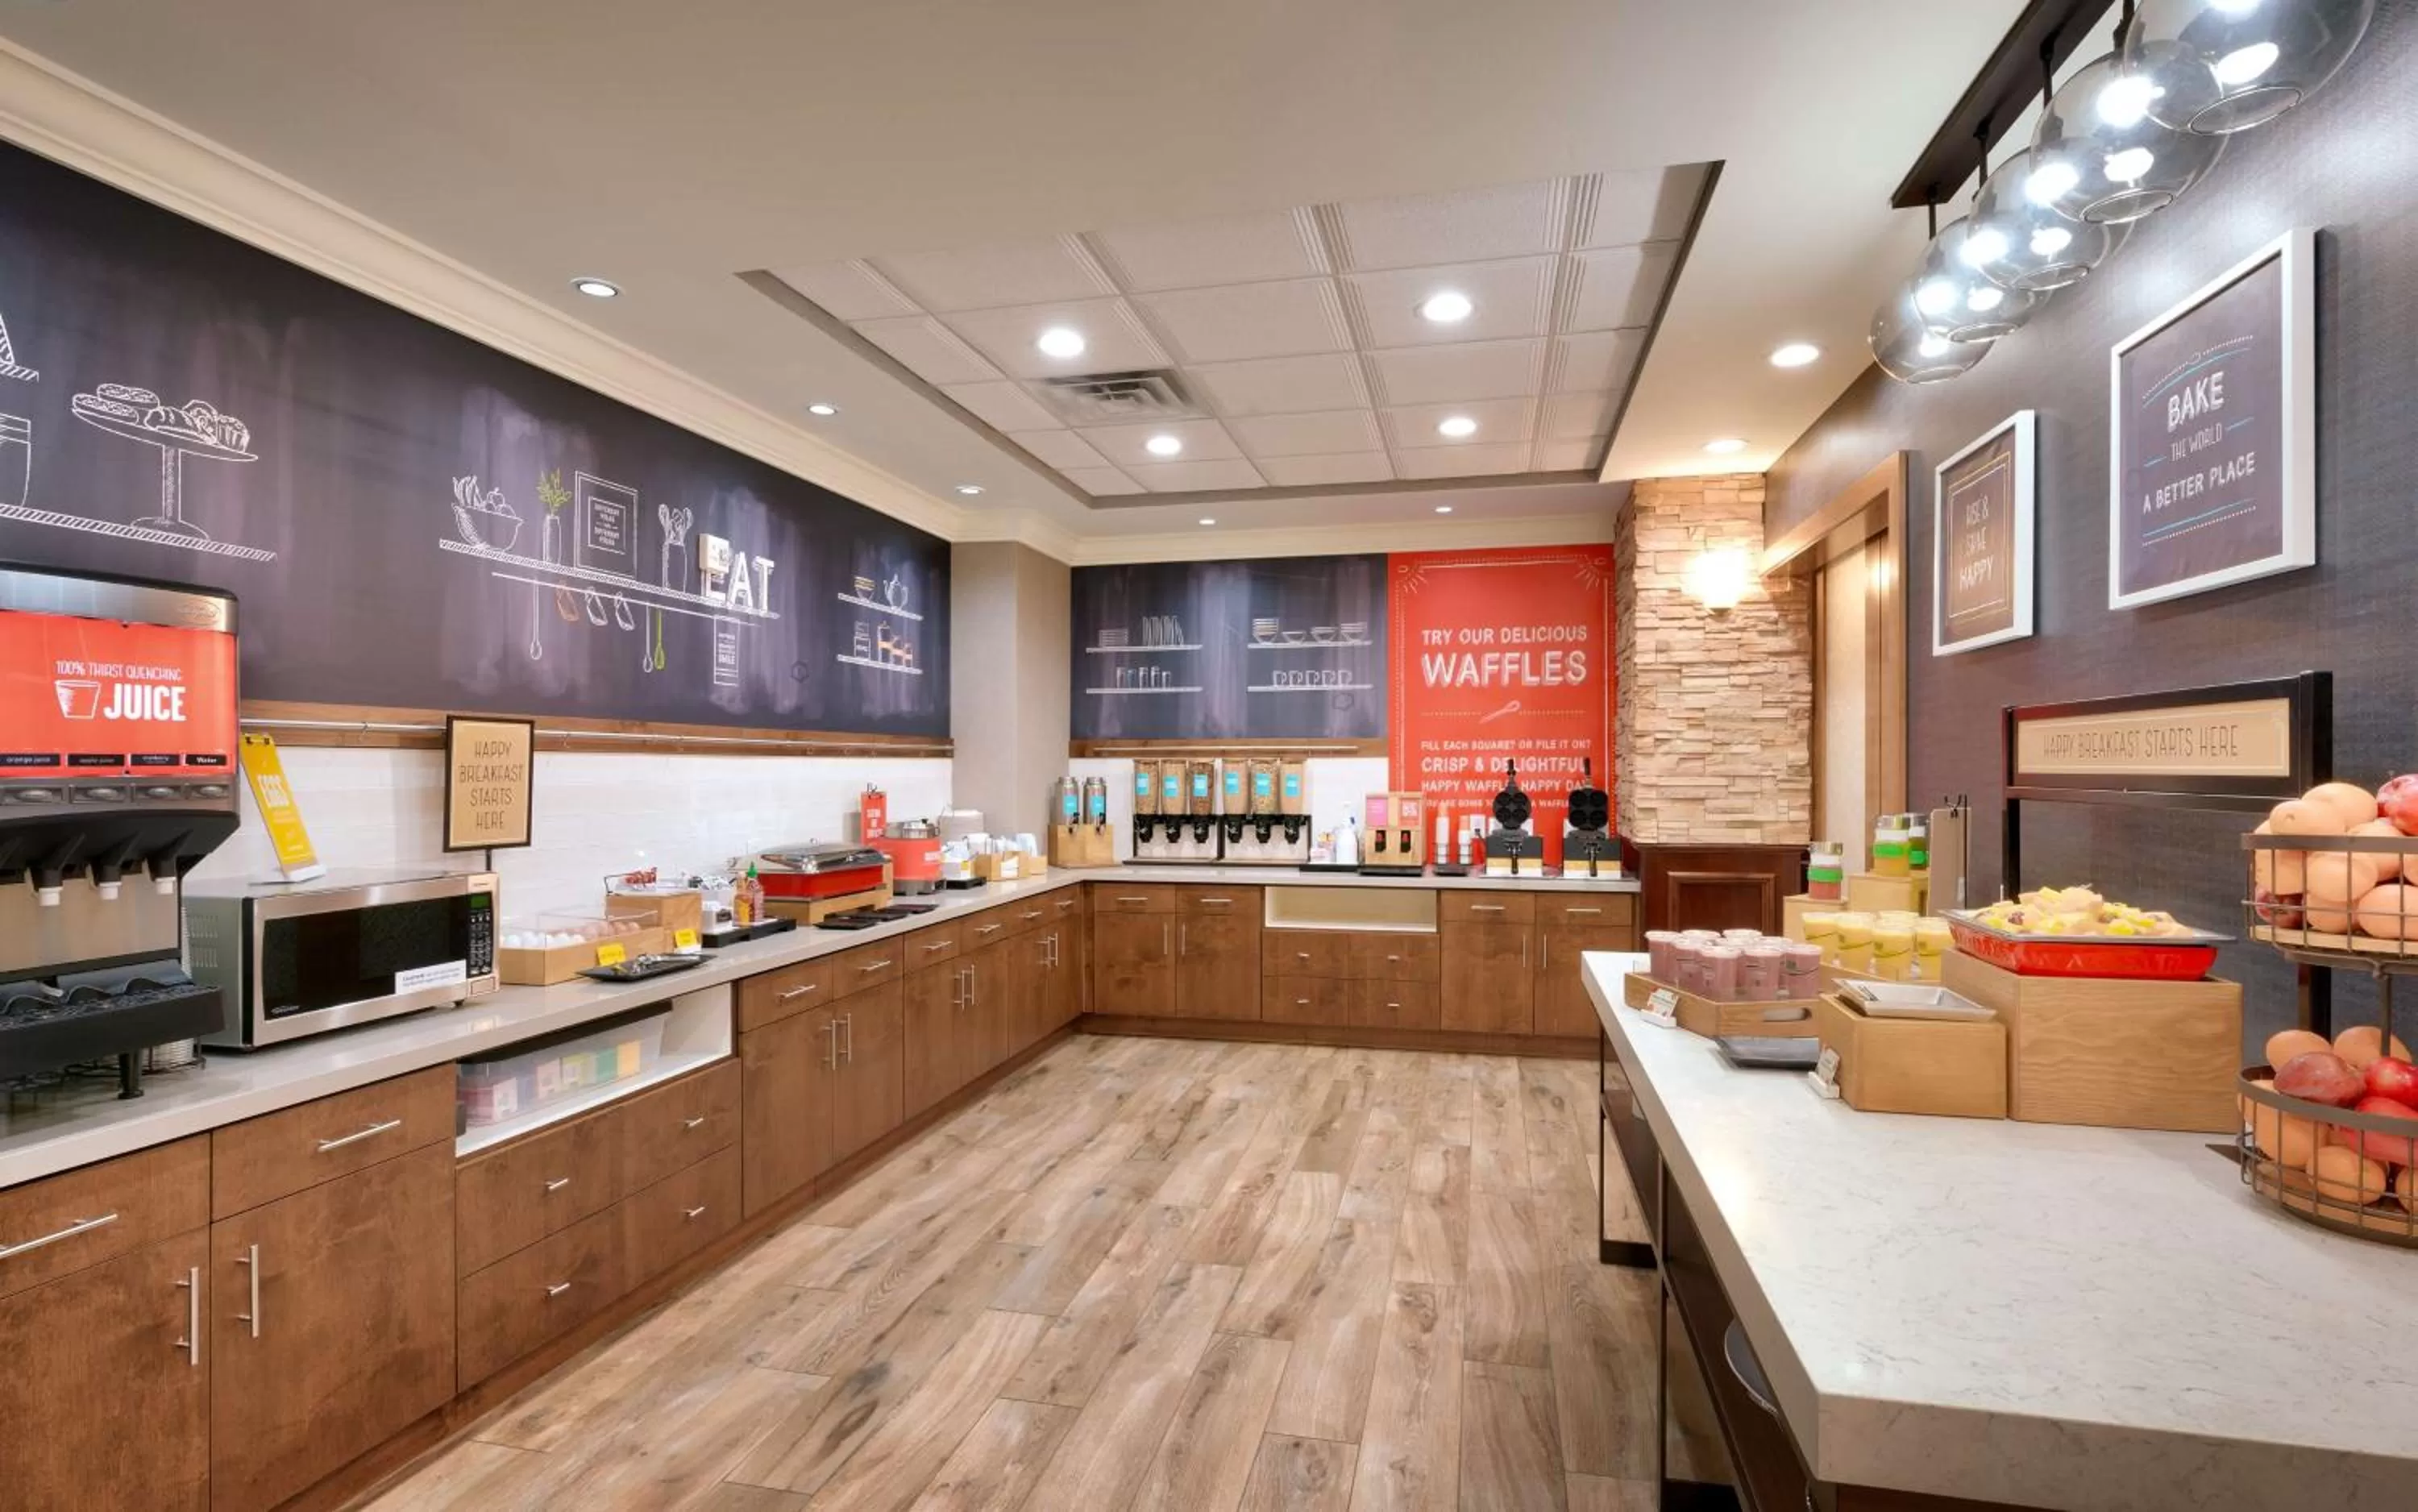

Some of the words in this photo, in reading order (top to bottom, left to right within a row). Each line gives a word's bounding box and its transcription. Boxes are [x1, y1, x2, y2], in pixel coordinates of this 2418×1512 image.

[2167, 371, 2224, 432] BAKE
[2190, 422, 2222, 452] WORLD
[2143, 493, 2151, 514] A
[2156, 473, 2204, 509] BETTER
[2210, 451, 2255, 489] PLACE
[1422, 629, 1453, 645] TRY
[1459, 628, 1494, 645] OUR
[1500, 625, 1587, 644] DELICIOUS
[56, 660, 85, 675] 100%
[89, 662, 123, 678] THIRST
[126, 665, 181, 681] QUENCHING
[1422, 650, 1587, 687] WAFFLES
[104, 683, 186, 721] JUICE
[475, 741, 512, 758] HAPPY
[1421, 741, 1440, 750] FILL
[1444, 741, 1468, 750] EACH
[1536, 739, 1556, 750] PILE
[1560, 739, 1568, 750] IT
[2043, 733, 2075, 759] HAPPY
[2078, 730, 2139, 759] BREAKFAST
[2145, 727, 2193, 758] STARTS
[2199, 725, 2238, 757] HERE
[459, 764, 523, 783] BREAKFAST
[1421, 757, 1469, 771] CRISP
[1474, 757, 1484, 771] &
[1491, 757, 1586, 772] DELIGHTFUL
[1421, 779, 1463, 792] HAPPY
[1465, 779, 1508, 792] WAFFL
[1521, 779, 1562, 791] HAPPY
[470, 787, 513, 807] STARTS
[476, 811, 505, 829] HERE
